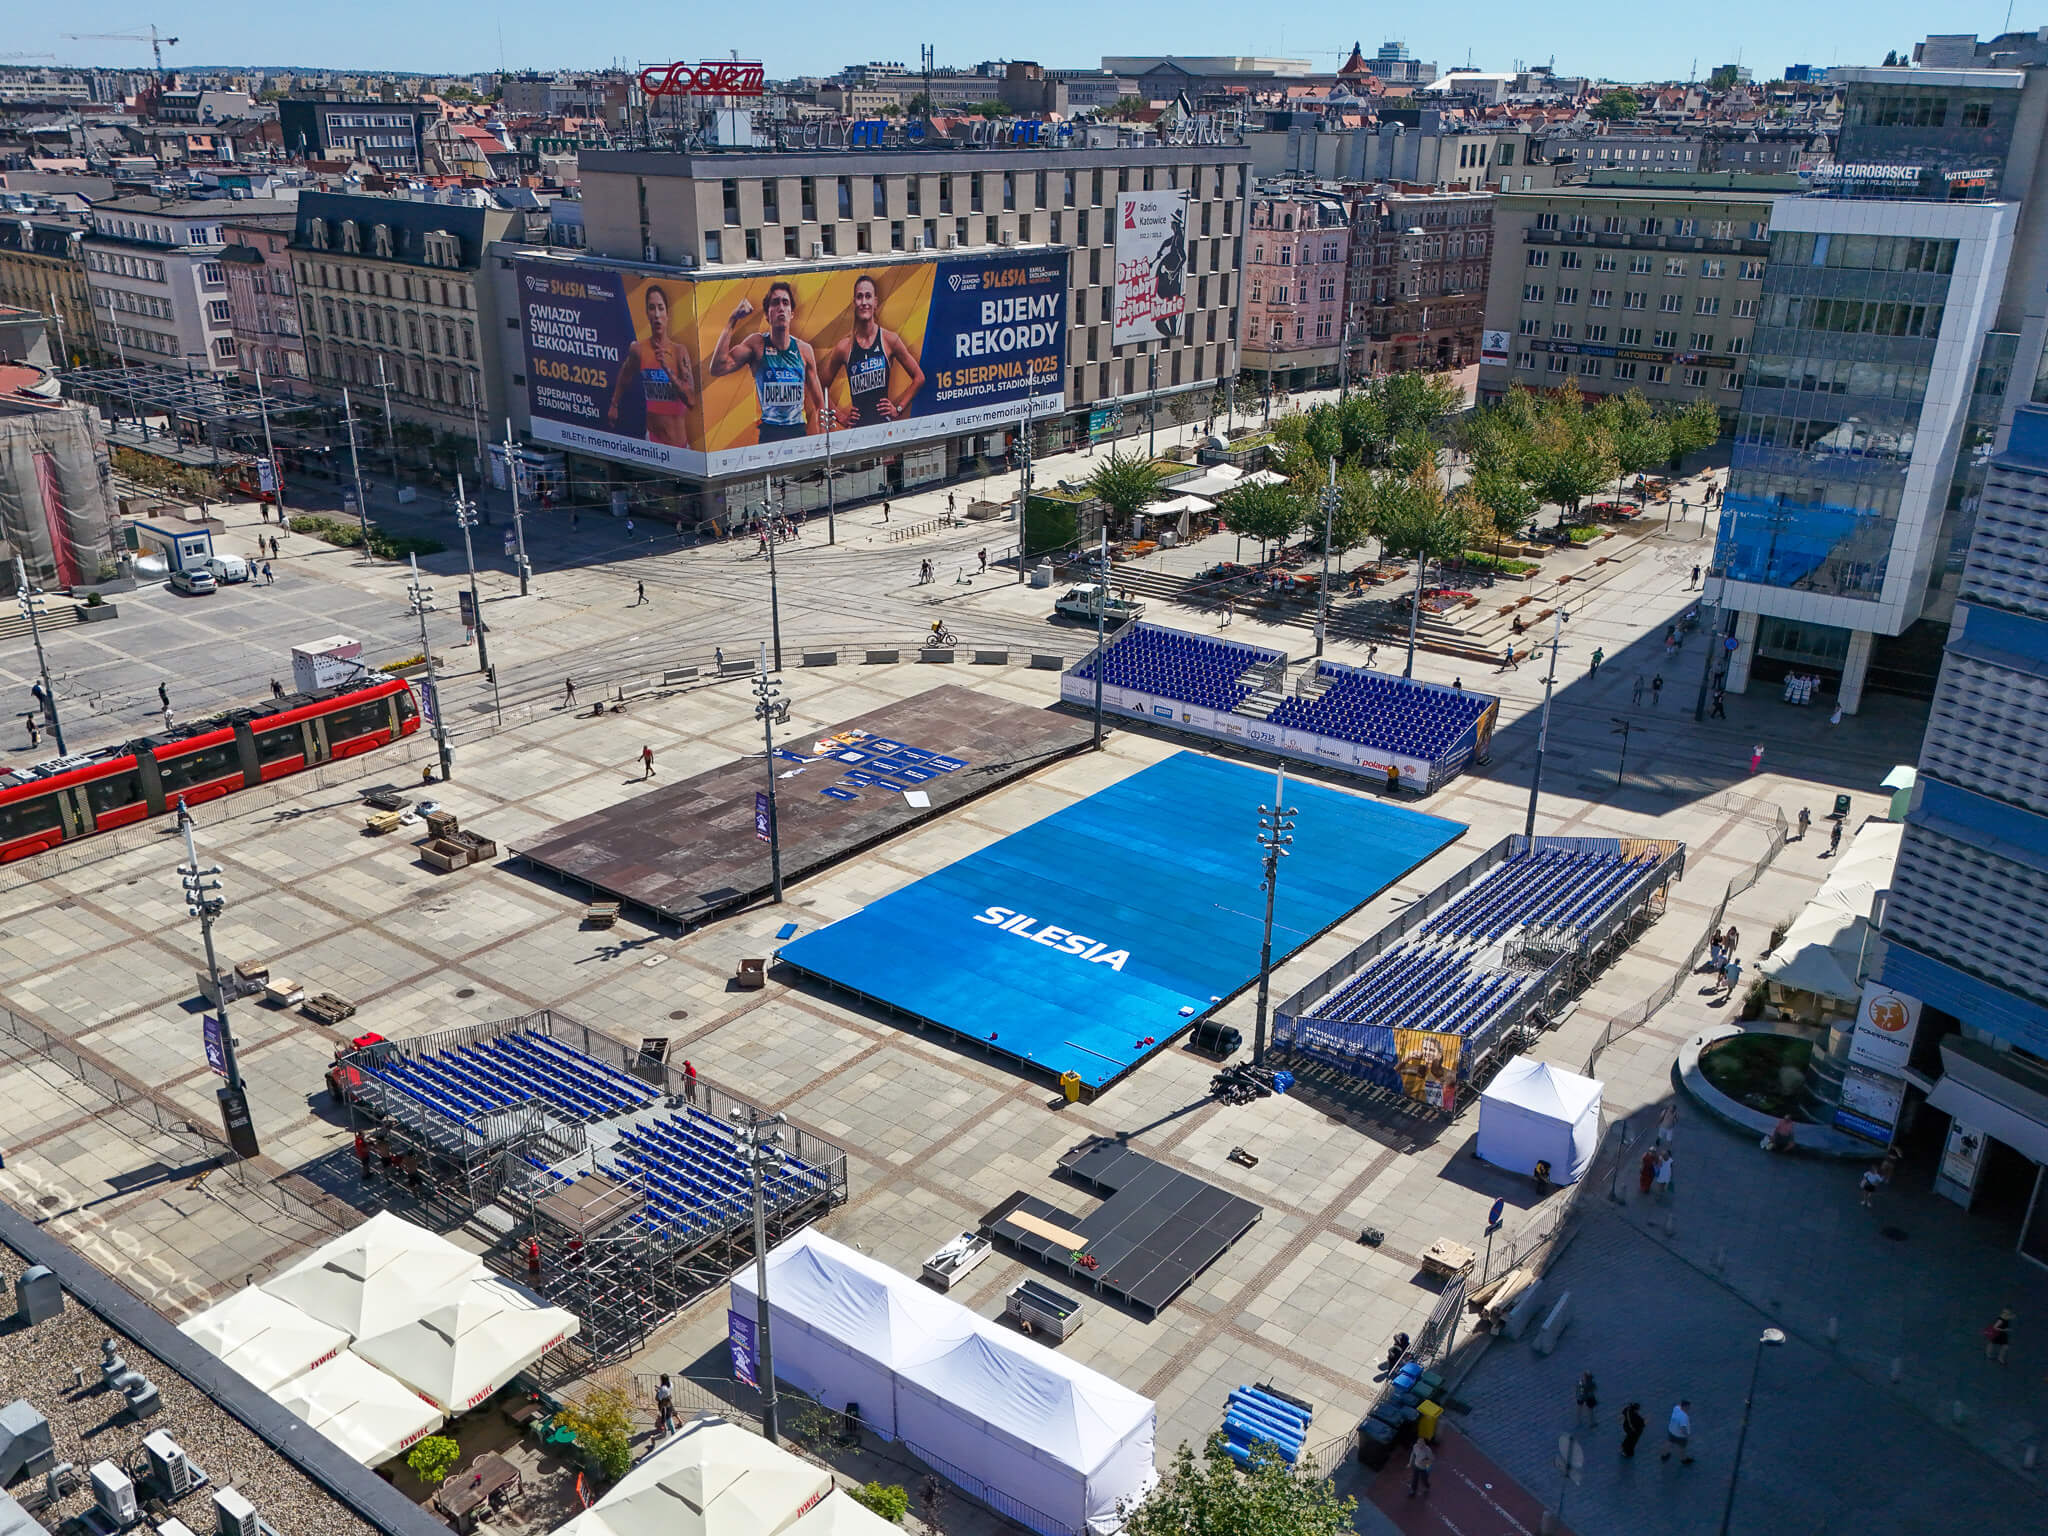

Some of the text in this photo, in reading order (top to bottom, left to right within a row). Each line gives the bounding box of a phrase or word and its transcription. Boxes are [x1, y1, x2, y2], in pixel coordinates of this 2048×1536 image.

[1815, 164, 1922, 180] FIBA EUROBASKET
[1944, 168, 1993, 181] KATOWICE
[1140, 203, 1157, 212] Radio
[1140, 216, 1167, 226] Katowice
[983, 268, 1027, 290] SILESIA
[1118, 256, 1151, 284] Dzień
[1126, 276, 1159, 300] dobry
[529, 303, 581, 324] GWIAZDY
[981, 293, 1060, 326] BIJEMY
[530, 315, 598, 343] ŚWIATOWEJ
[956, 321, 1060, 358] REKORDY
[532, 333, 619, 362] LEKKOATLETYKI
[533, 357, 608, 388] 16.08.2025
[936, 355, 1058, 389] 16 SIERPNIA 2025
[536, 385, 594, 406] SUPERAUTO.PL
[766, 384, 801, 402] DUPLANTIS
[936, 372, 1058, 401] SUPERAUTO.PL STADION ŚLĄSKI
[538, 397, 600, 418] STADION ŚLĄSKI
[956, 398, 1057, 426] BILETY: memorialkamili.pl
[561, 430, 670, 463] BILETY: memorialkamili.pl
[972, 906, 1130, 972] SILESIA
